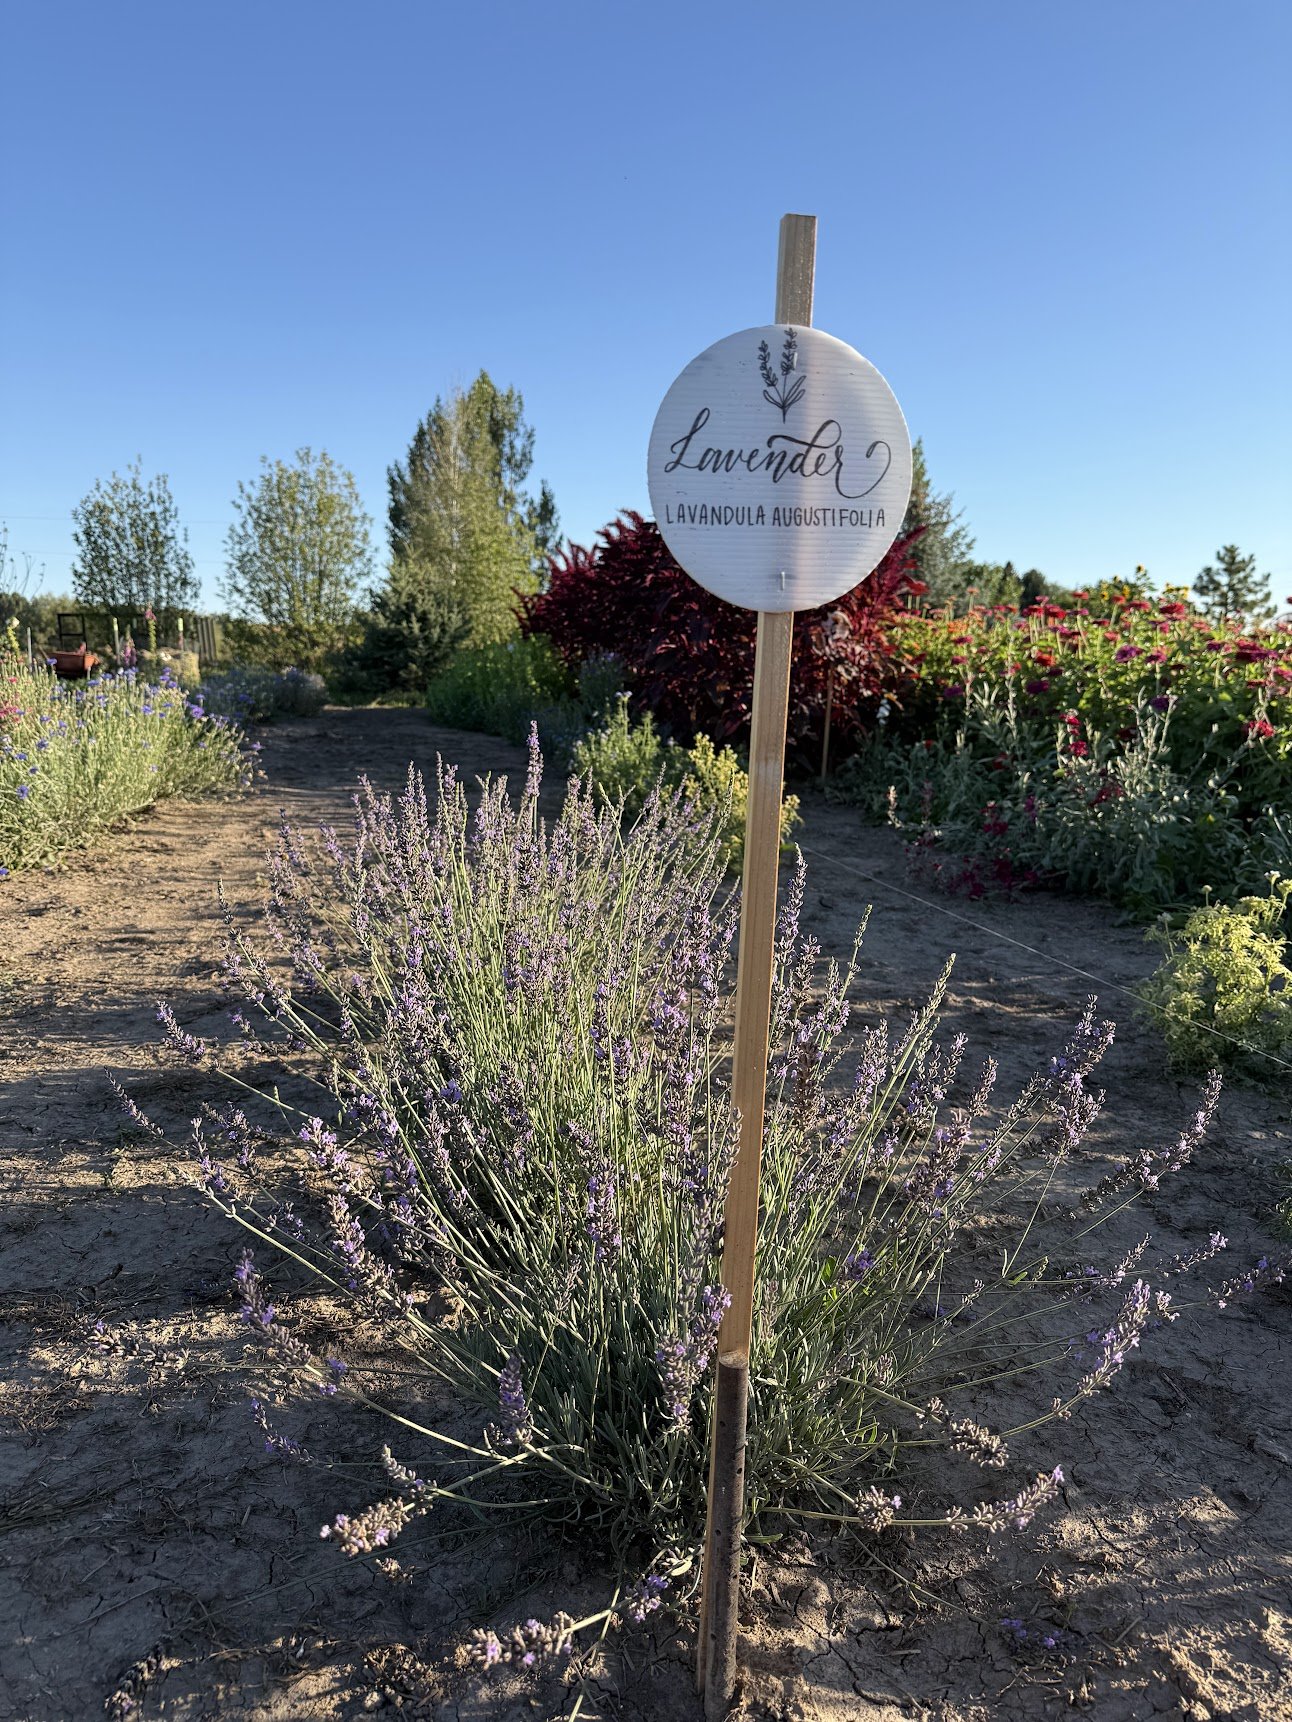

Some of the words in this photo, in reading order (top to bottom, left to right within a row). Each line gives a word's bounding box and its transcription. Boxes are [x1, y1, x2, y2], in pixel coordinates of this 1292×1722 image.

[664, 407, 891, 498] Lavender
[665, 503, 765, 526] LAVANDULA
[772, 506, 885, 528] AUGUSTIFOLIA
